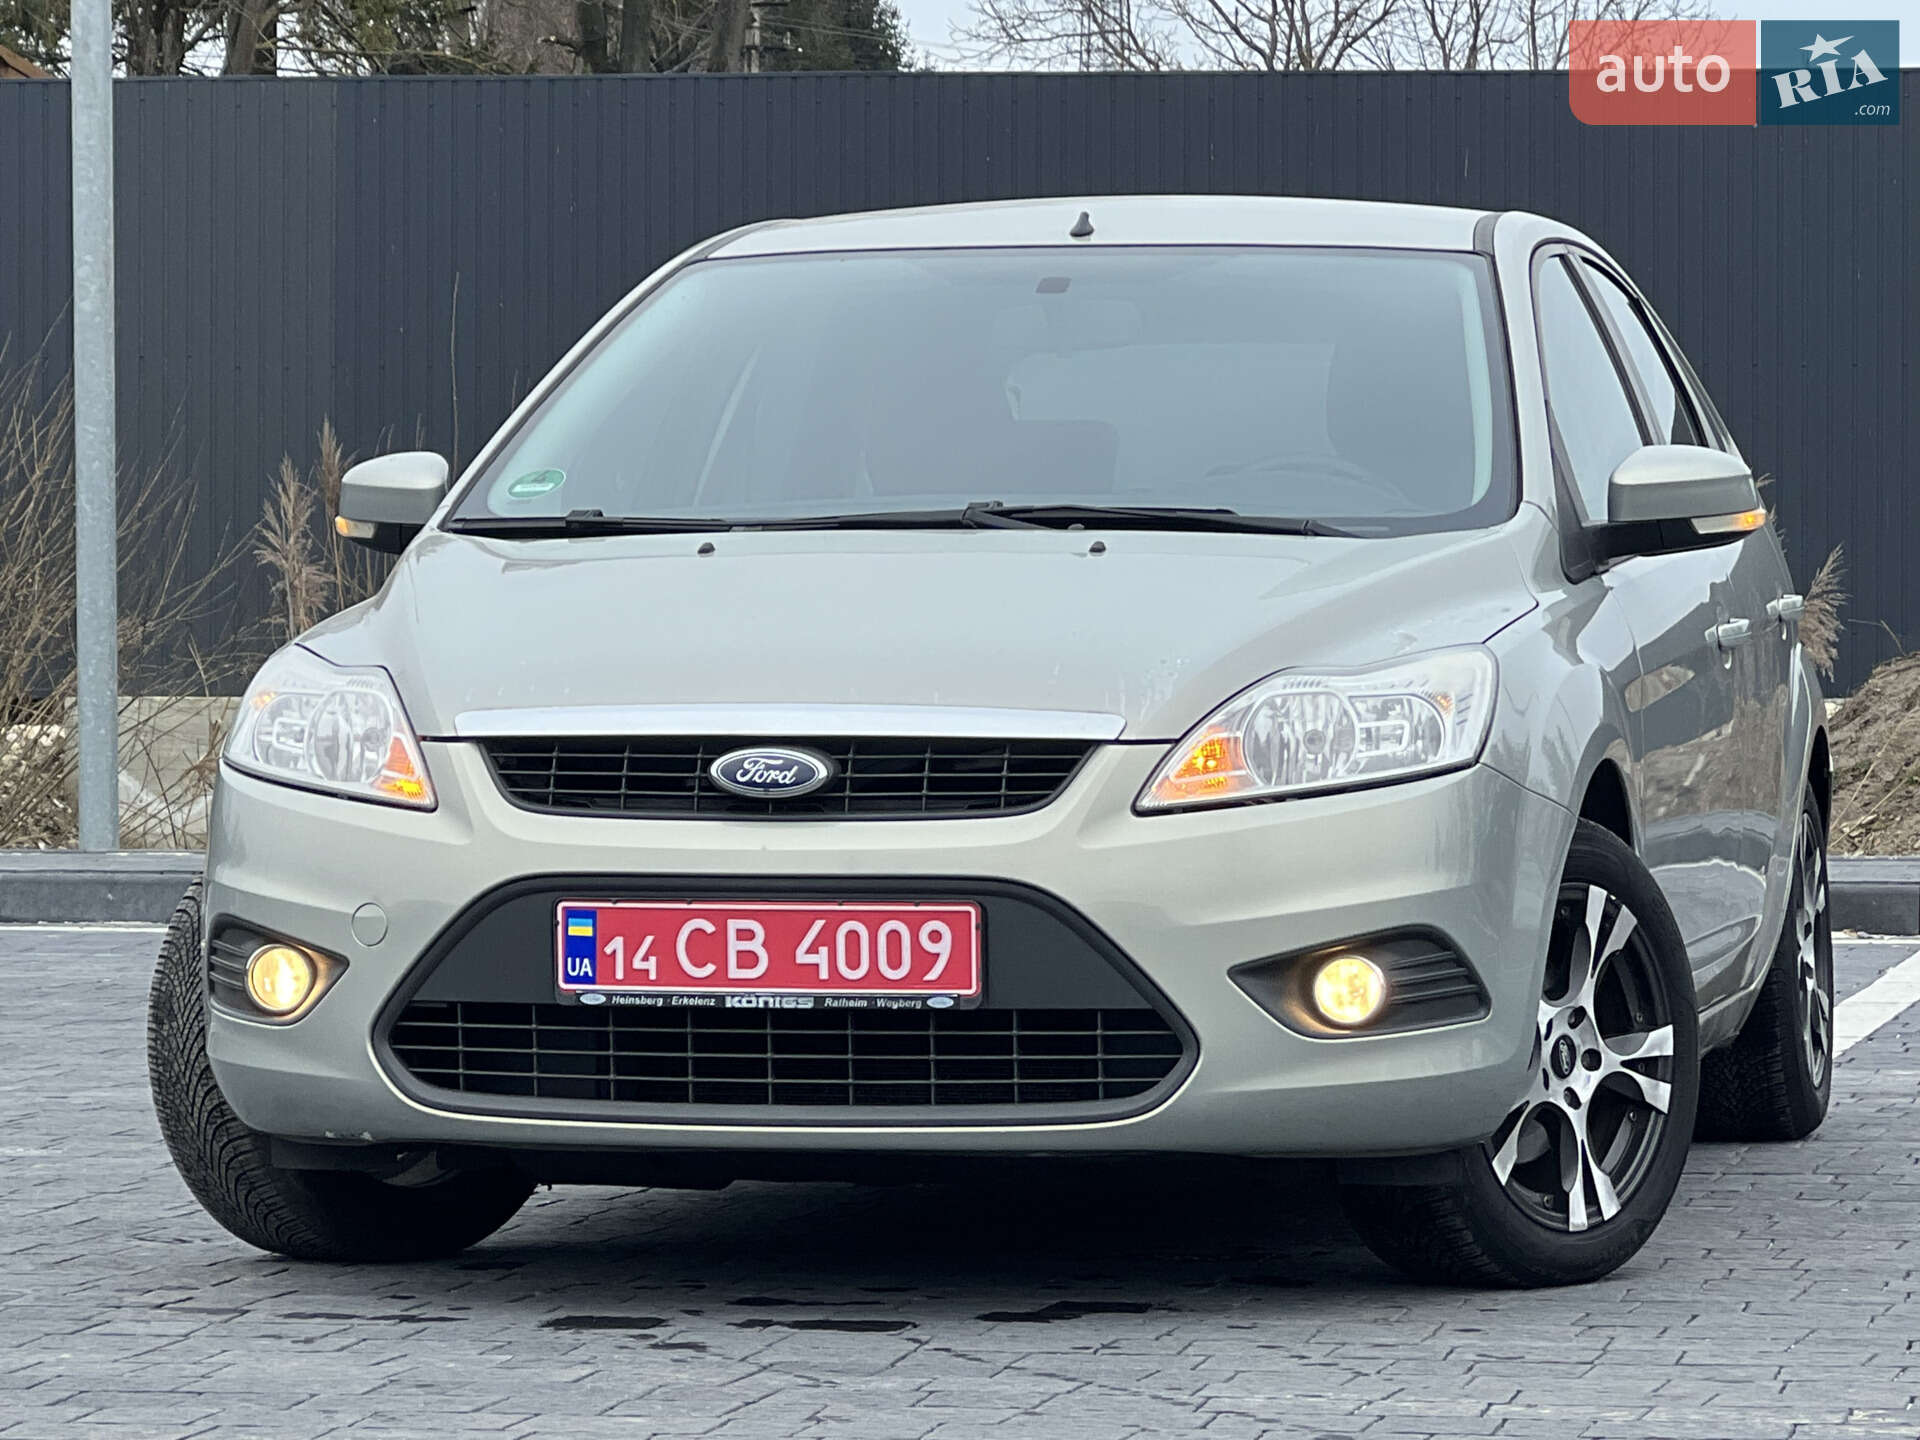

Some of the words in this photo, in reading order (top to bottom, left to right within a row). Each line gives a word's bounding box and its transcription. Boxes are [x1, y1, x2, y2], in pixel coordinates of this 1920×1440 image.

[735, 757, 799, 784] Ford
[603, 935, 658, 980] 14
[675, 918, 769, 980] CB
[795, 919, 952, 981] 4009
[567, 957, 593, 977] UA
[611, 995, 663, 1007] Heinsberg
[671, 996, 716, 1006] Erkelenz
